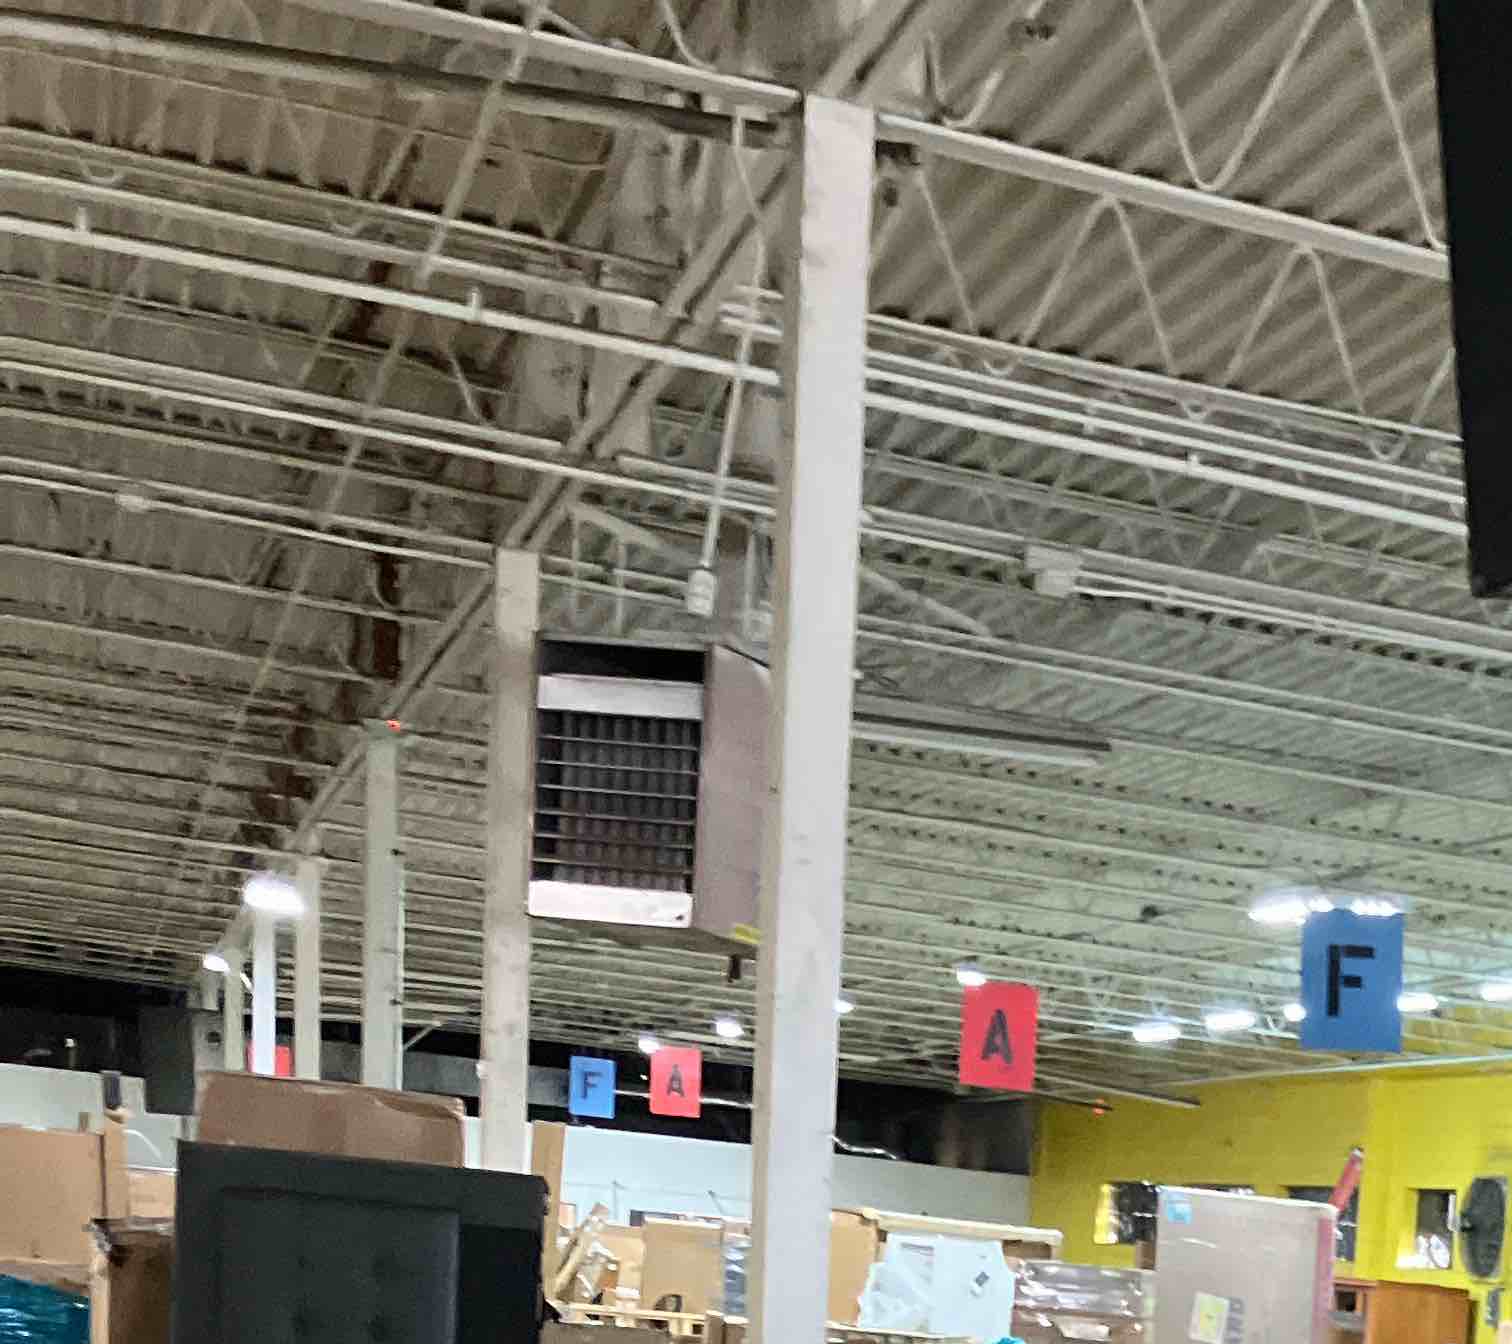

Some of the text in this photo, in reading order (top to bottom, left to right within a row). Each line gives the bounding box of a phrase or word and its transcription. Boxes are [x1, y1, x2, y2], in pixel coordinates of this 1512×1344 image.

[1326, 943, 1376, 1018] F
[980, 1008, 1013, 1065] A
[580, 1070, 605, 1101] F
[666, 1063, 686, 1098] A
